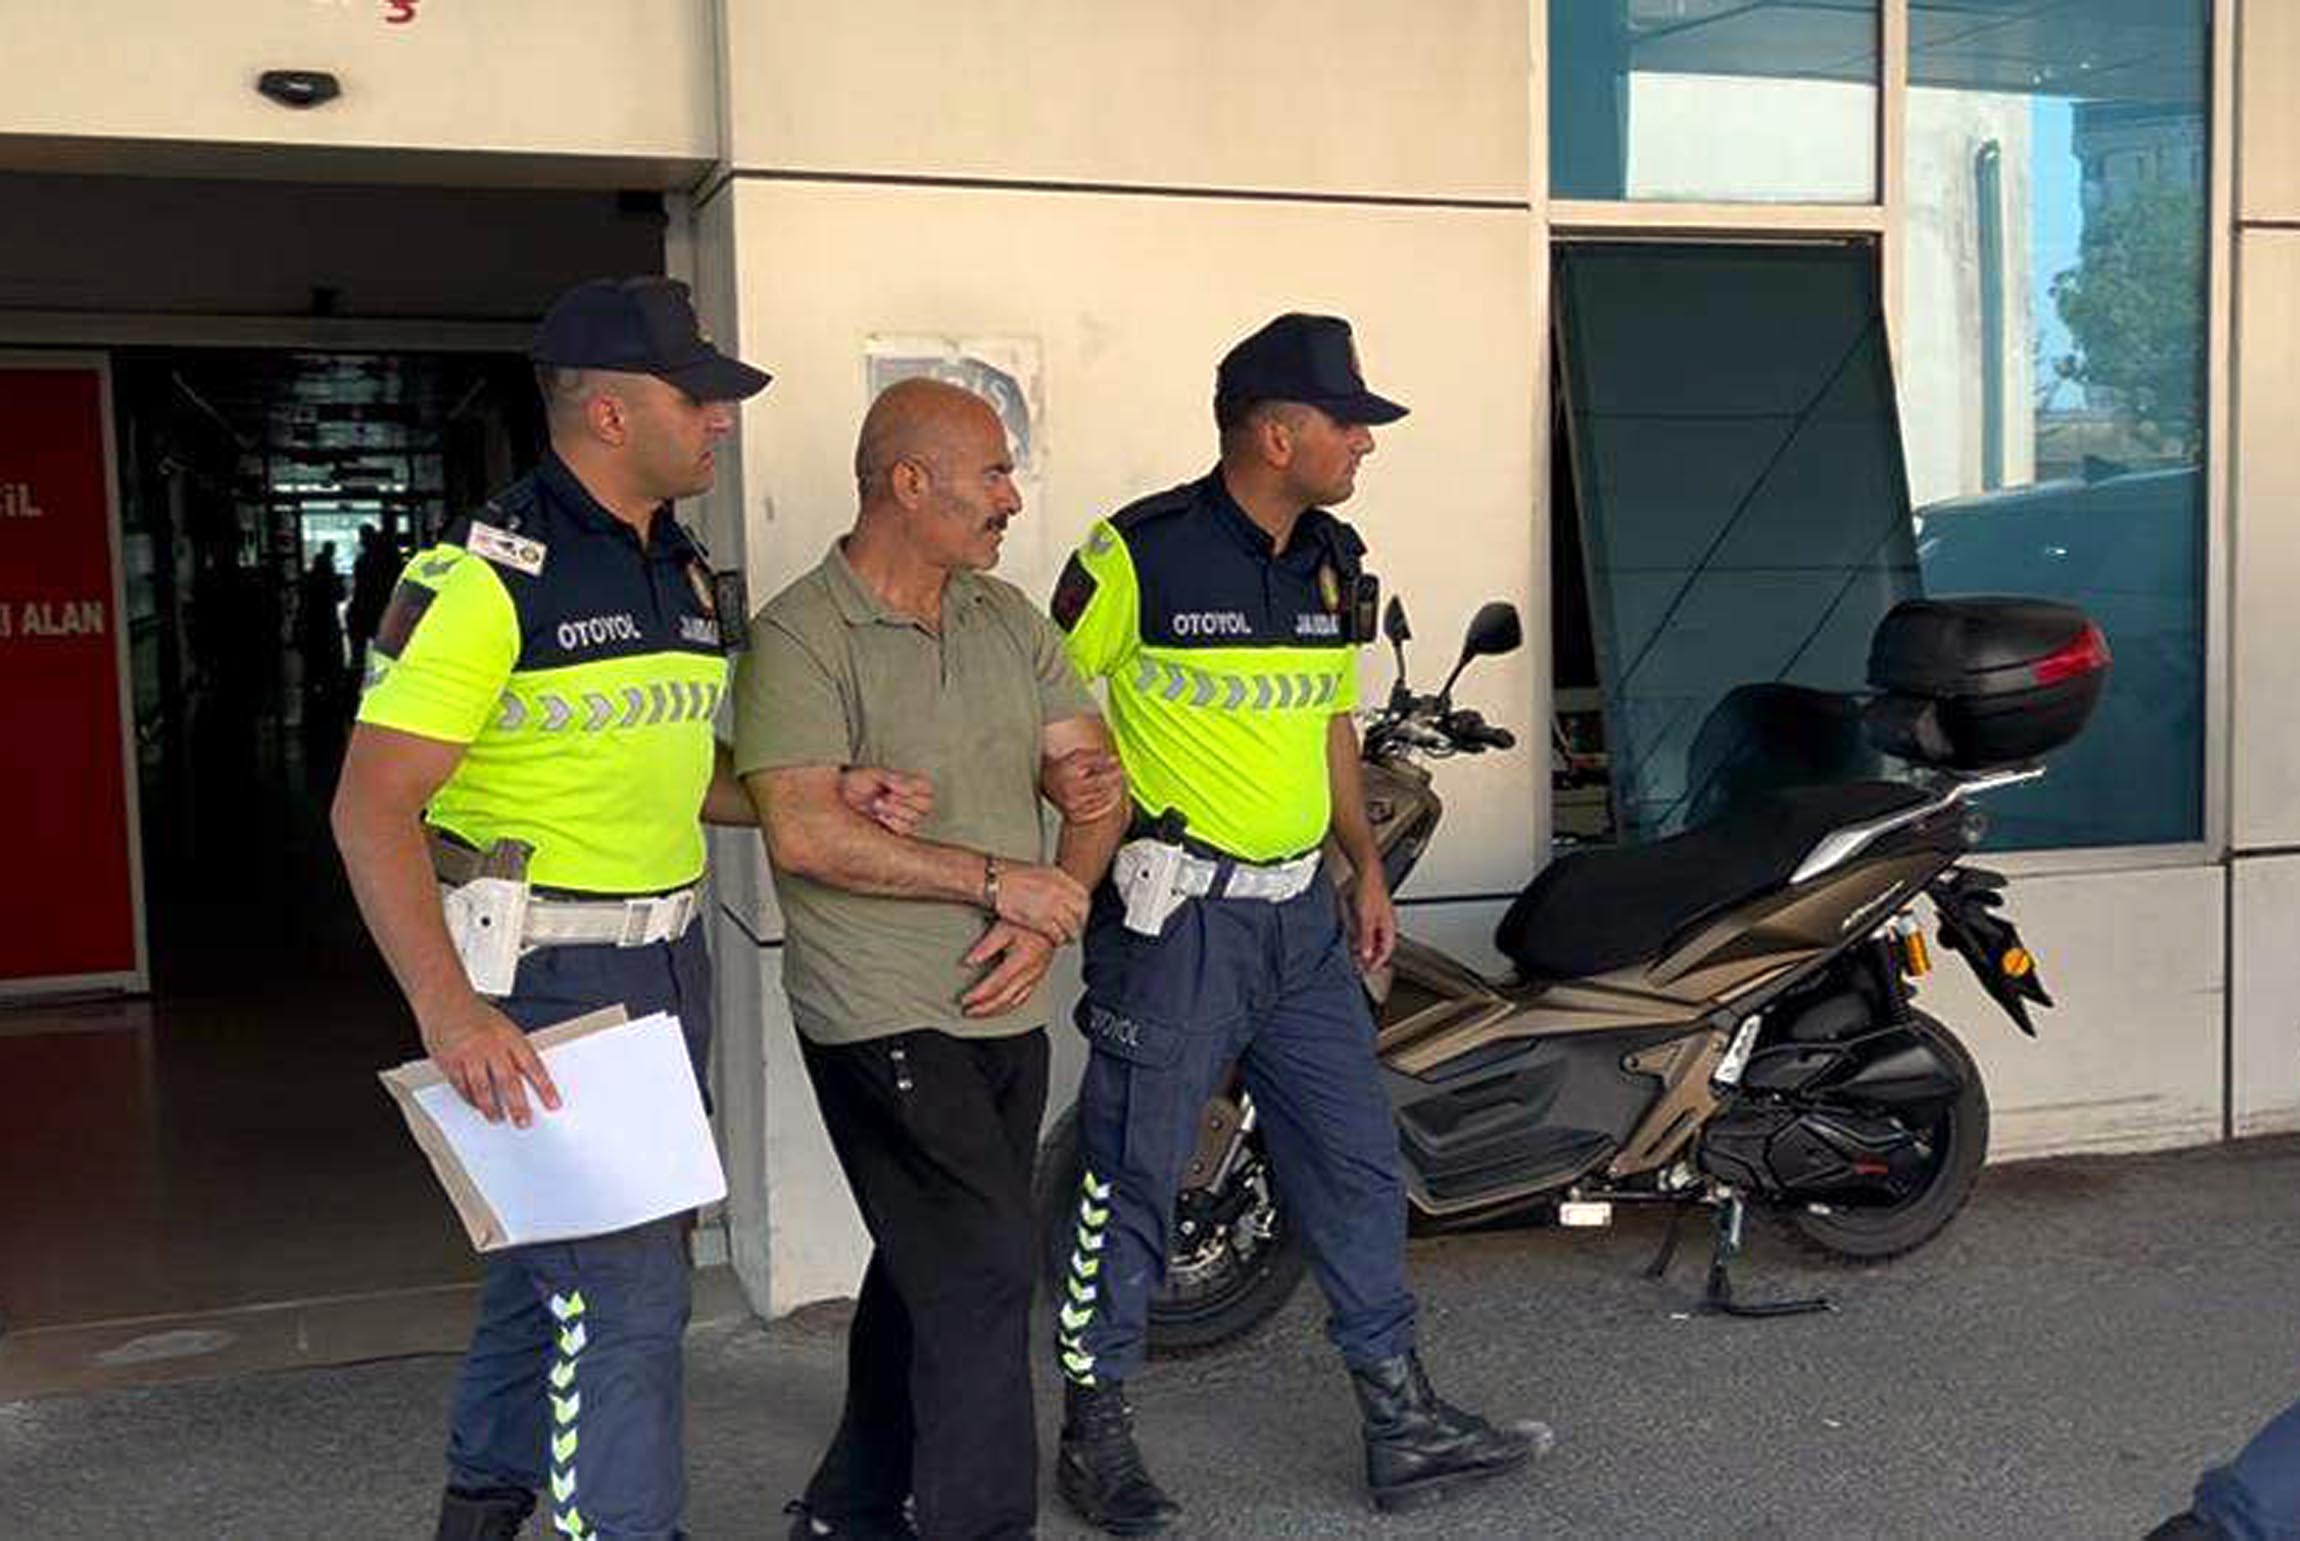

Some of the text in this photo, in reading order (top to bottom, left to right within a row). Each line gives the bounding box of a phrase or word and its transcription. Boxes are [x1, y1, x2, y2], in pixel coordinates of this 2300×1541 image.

[0, 483, 43, 518] İL
[22, 601, 104, 635] ALAN
[557, 613, 642, 650] OTOYOL
[1173, 611, 1252, 636] OTOYOL
